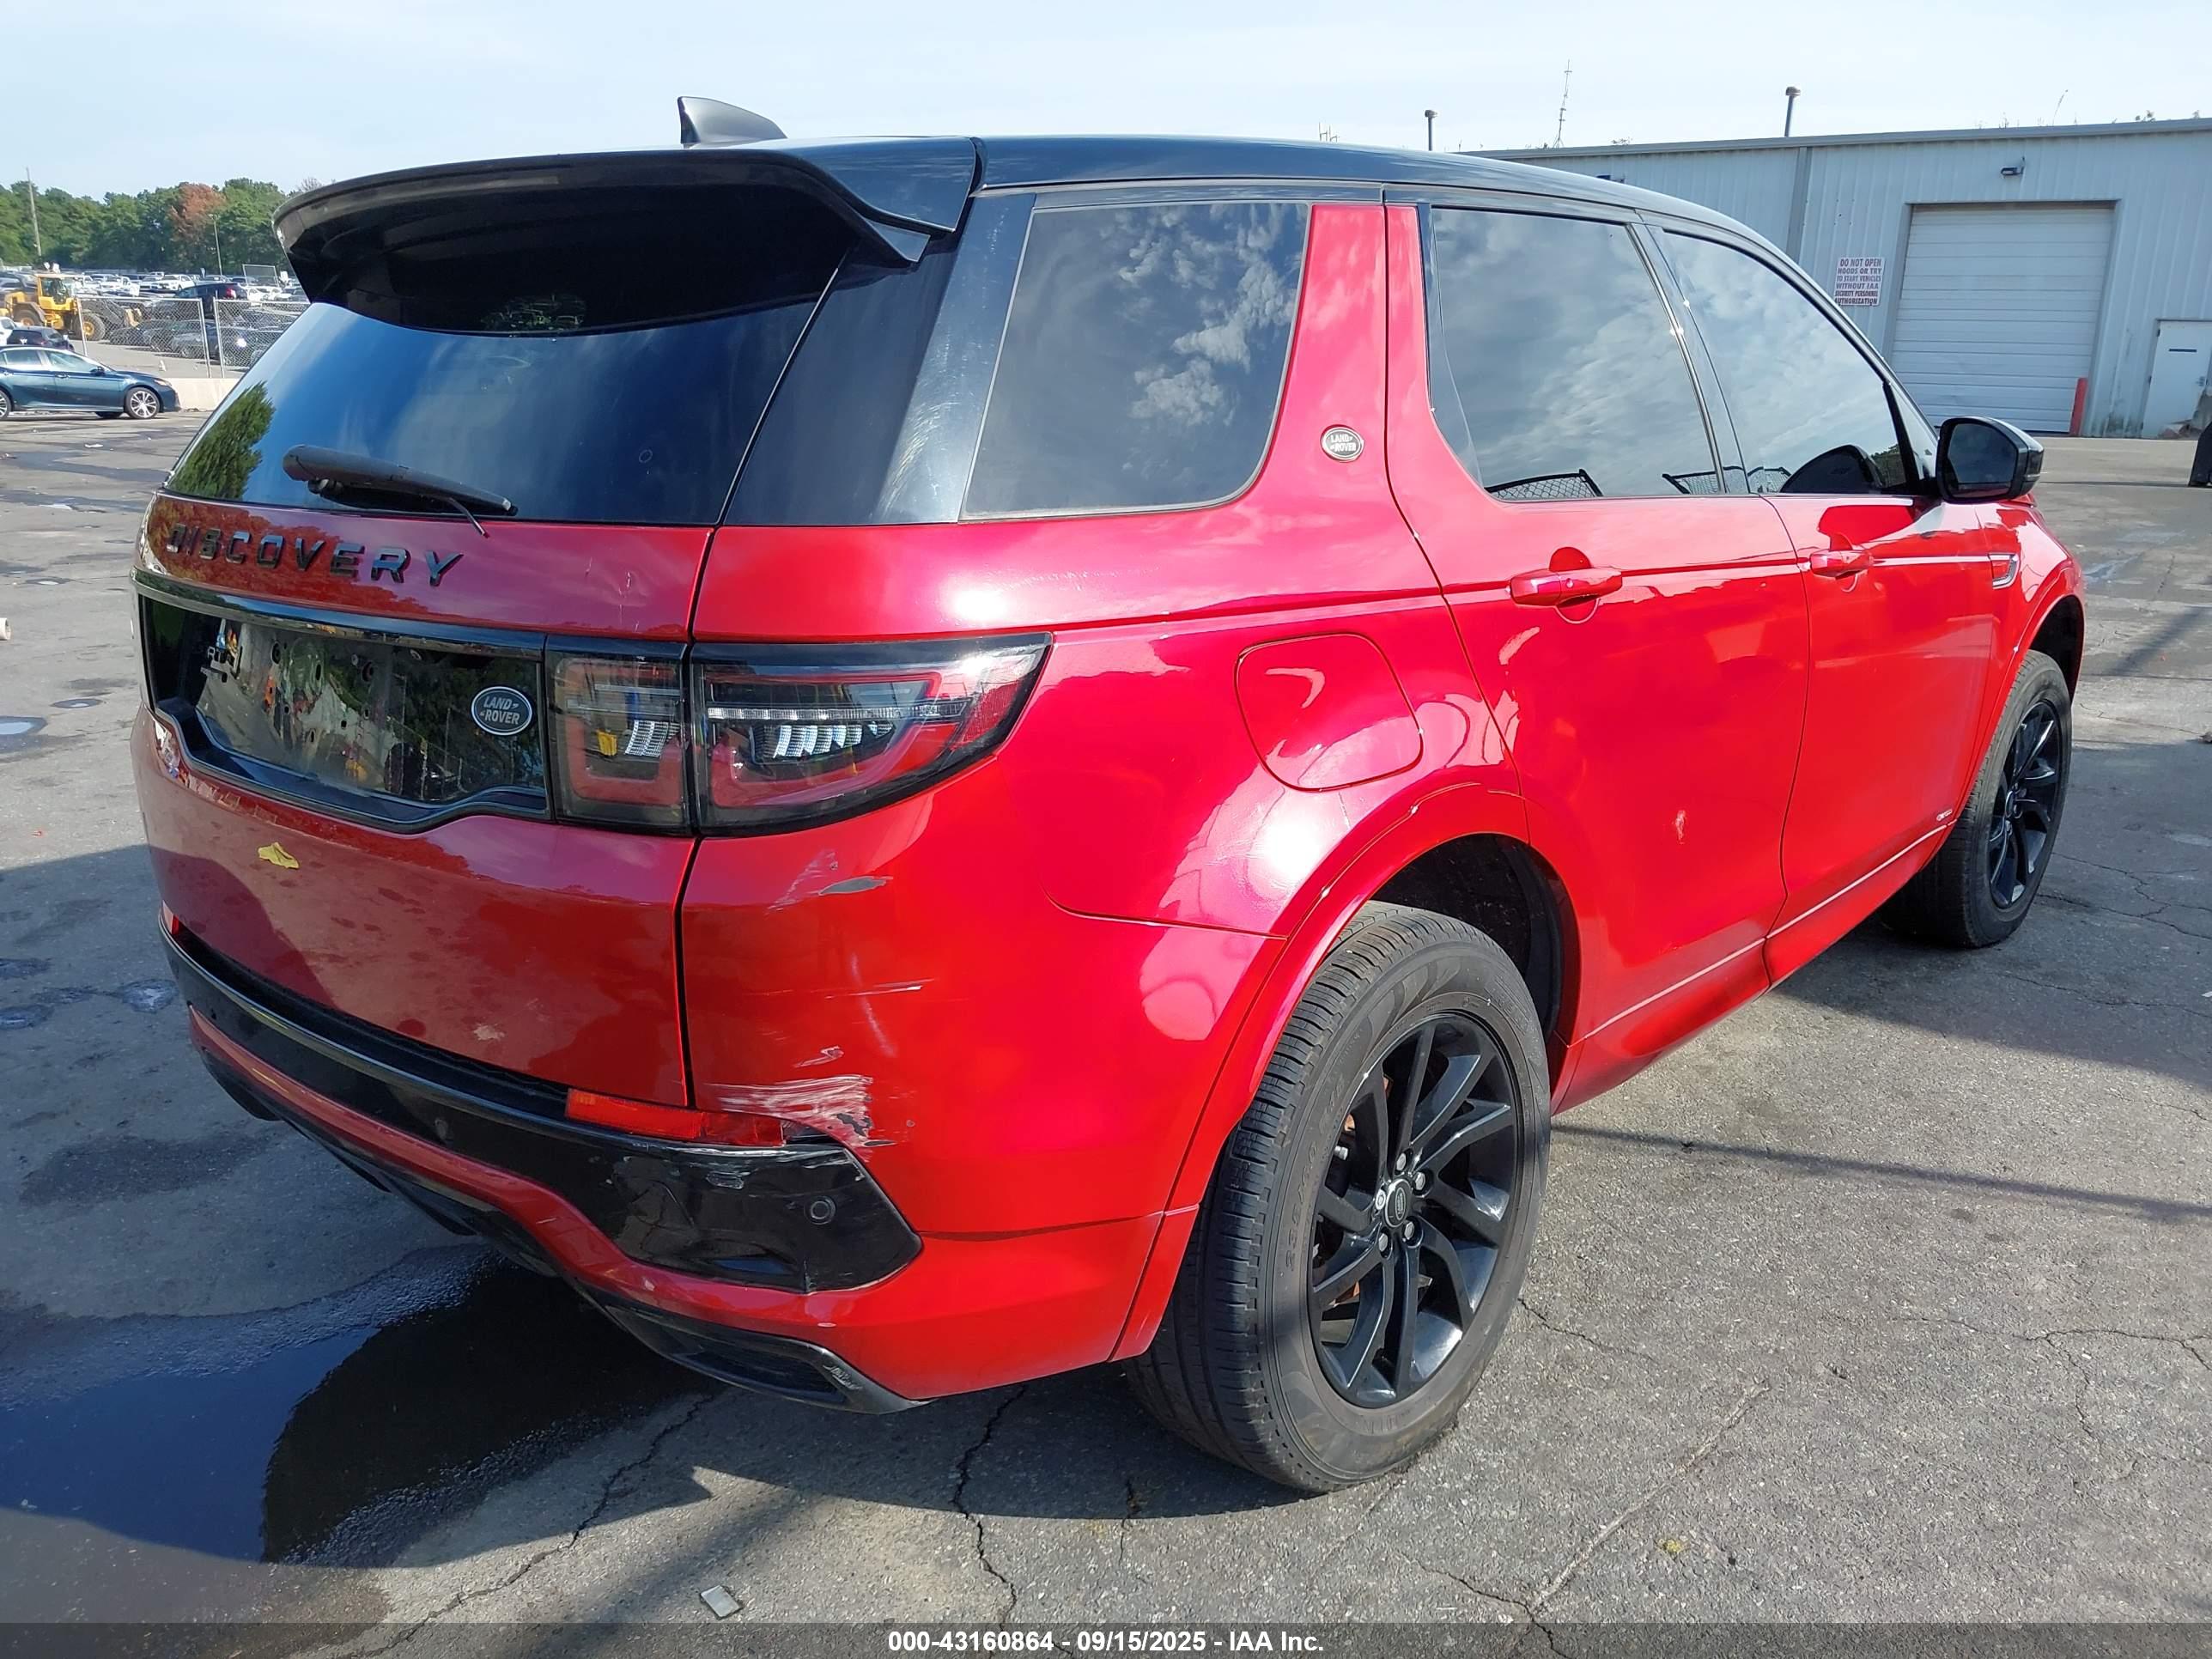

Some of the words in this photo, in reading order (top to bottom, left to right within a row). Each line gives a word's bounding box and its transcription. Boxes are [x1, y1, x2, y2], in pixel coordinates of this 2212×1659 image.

[1334, 443, 1356, 452] ROVER
[166, 523, 465, 587] DISCOVERY
[483, 696, 513, 709] LAND
[484, 709, 520, 725] ROVER
